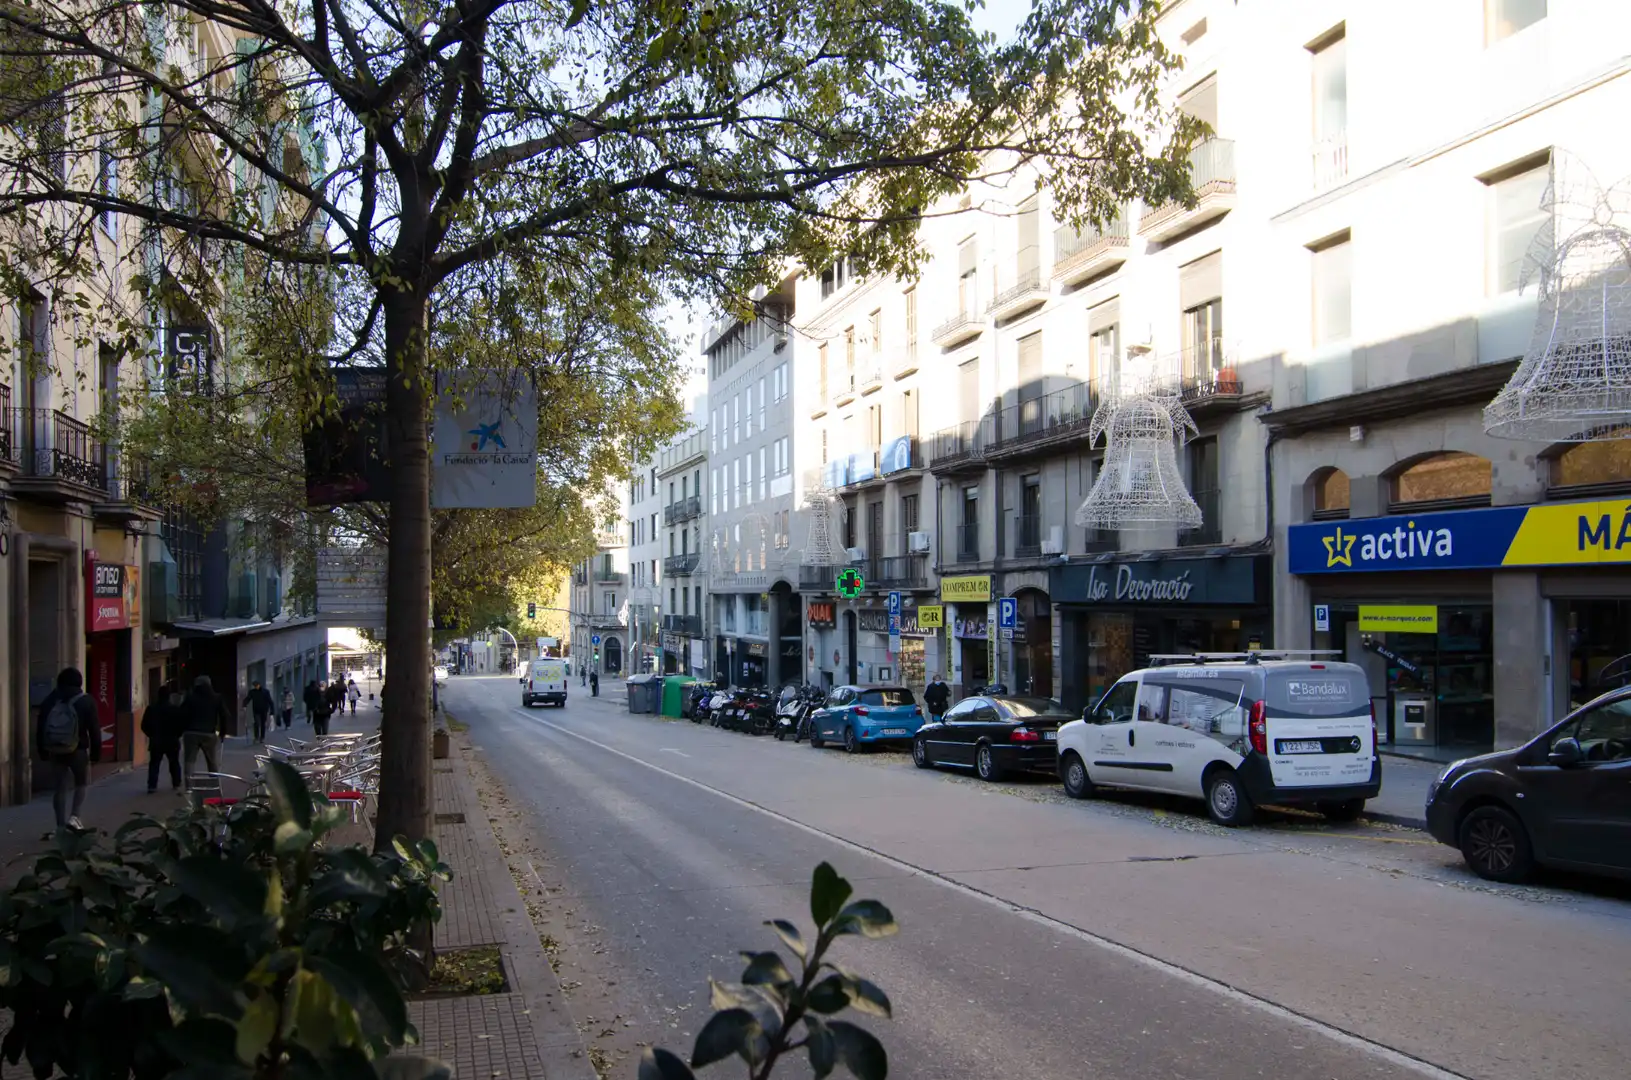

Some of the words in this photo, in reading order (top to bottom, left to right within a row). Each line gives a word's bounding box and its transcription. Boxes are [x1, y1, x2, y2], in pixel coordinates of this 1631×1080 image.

[444, 454, 488, 465] Fundació
[1360, 520, 1453, 561] activa
[942, 581, 977, 594] COMPREM
[1087, 565, 1109, 601] Isa
[1115, 564, 1195, 601] Decoració
[890, 594, 898, 613] P
[1002, 601, 1013, 625] P
[1318, 609, 1325, 620] P
[1377, 645, 1395, 659] BLACK
[1301, 682, 1348, 695] Bandalux
[1284, 741, 1304, 751] 1221
